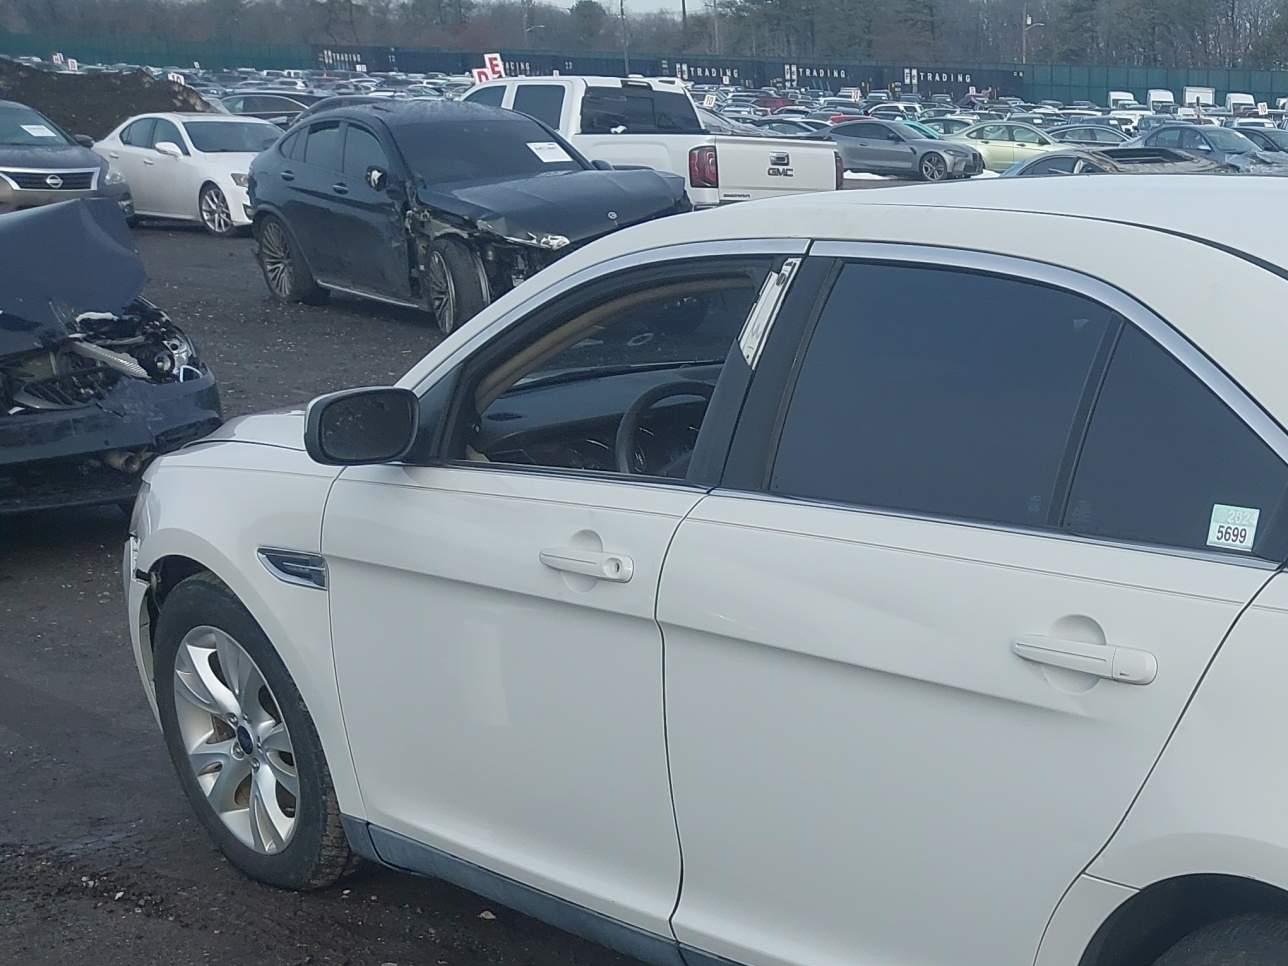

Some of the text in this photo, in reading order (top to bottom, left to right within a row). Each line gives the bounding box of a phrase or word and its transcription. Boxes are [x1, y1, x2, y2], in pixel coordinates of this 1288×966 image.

[487, 57, 501, 75] E
[690, 67, 738, 78] TRADING
[799, 68, 846, 78] TRADING
[920, 73, 971, 83] TRADING
[767, 167, 794, 177] GMC
[1217, 525, 1247, 544] 5699
